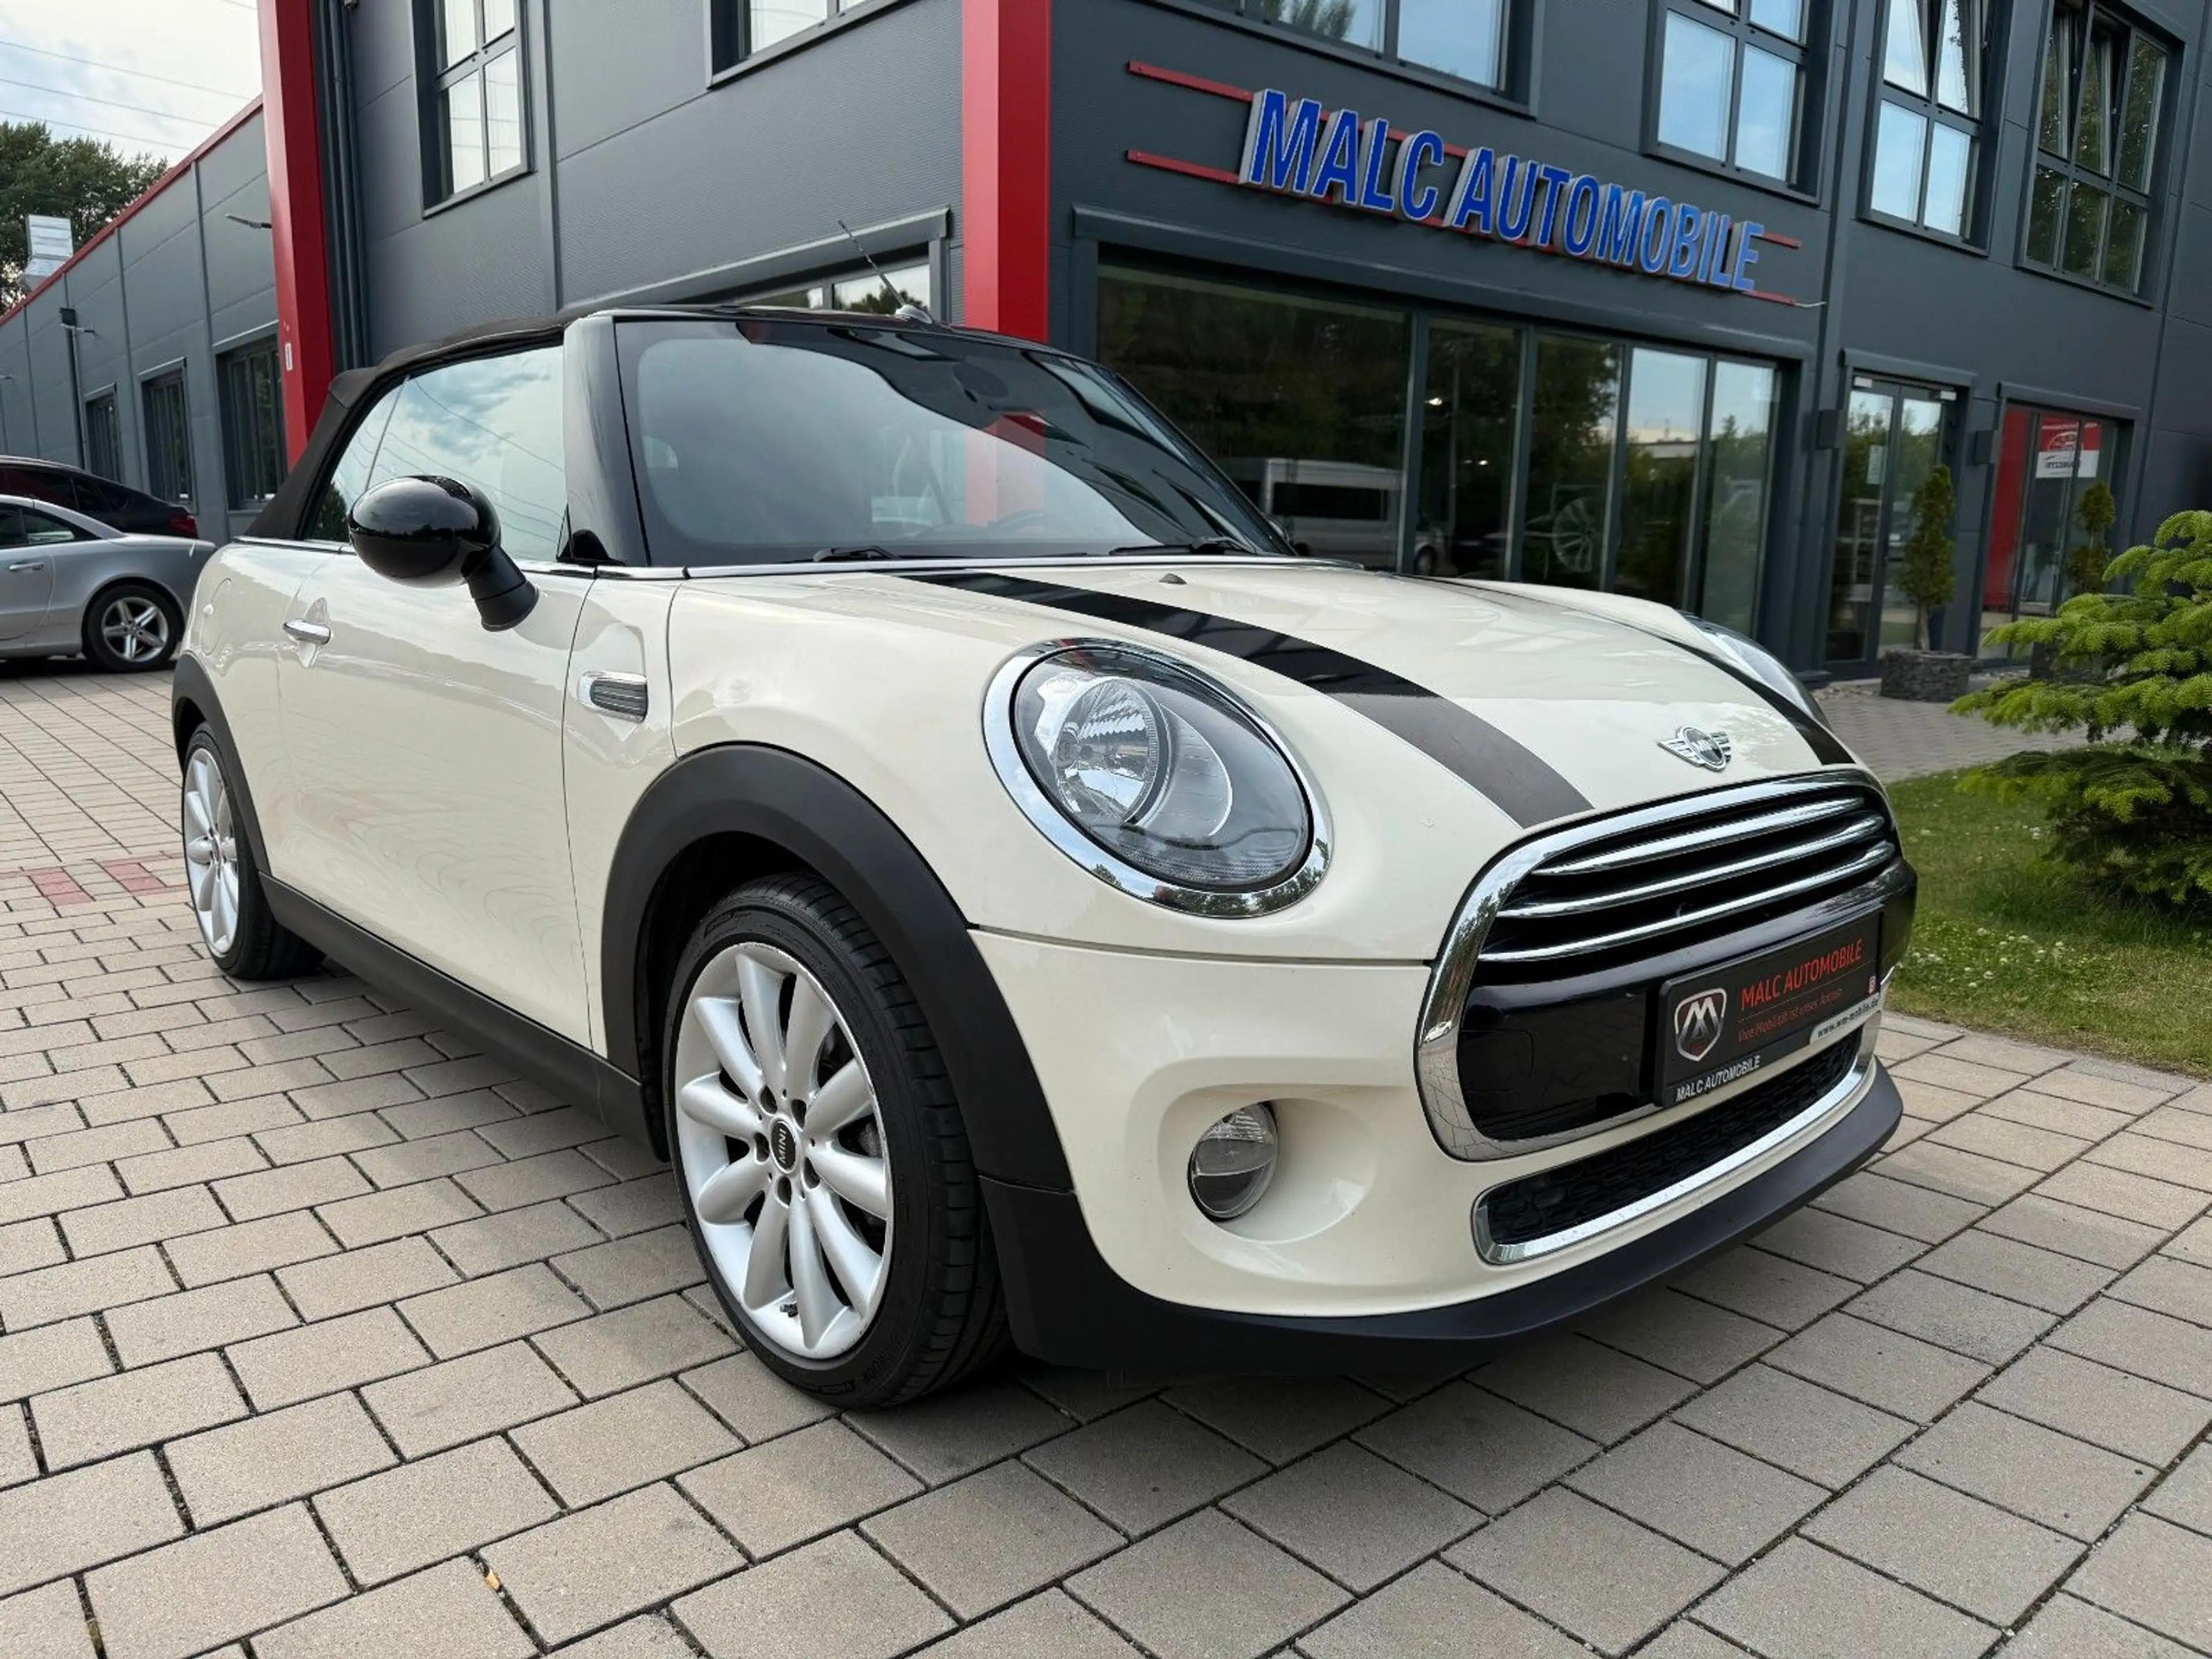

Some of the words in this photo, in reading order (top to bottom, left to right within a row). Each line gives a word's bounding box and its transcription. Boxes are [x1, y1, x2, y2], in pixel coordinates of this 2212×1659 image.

[1241, 88, 1445, 221] MALC
[1447, 146, 1765, 292] AUTOMOBILE
[1740, 974, 1782, 1011] MALC
[1783, 937, 1864, 994] AUTOMOBILE
[1676, 1079, 1704, 1103] MALC
[1704, 1054, 1761, 1090] AUTOMOBILE
[778, 1127, 786, 1164] MINI
